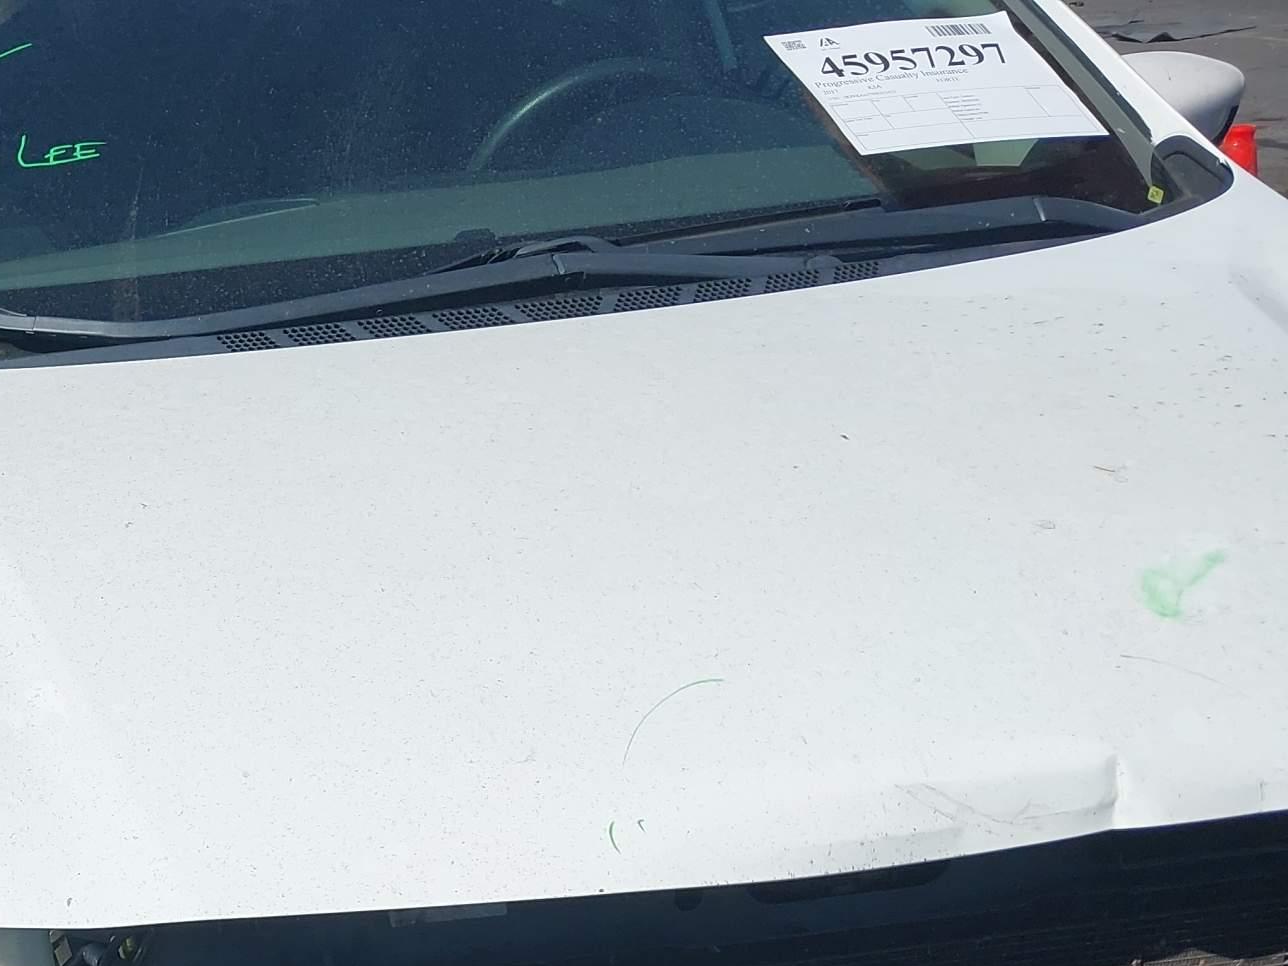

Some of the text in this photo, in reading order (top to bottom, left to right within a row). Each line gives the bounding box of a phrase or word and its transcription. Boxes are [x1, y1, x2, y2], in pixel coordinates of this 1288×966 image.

[820, 43, 1006, 78] 45957297
[814, 68, 969, 88] Progressive Casualty Insurance
